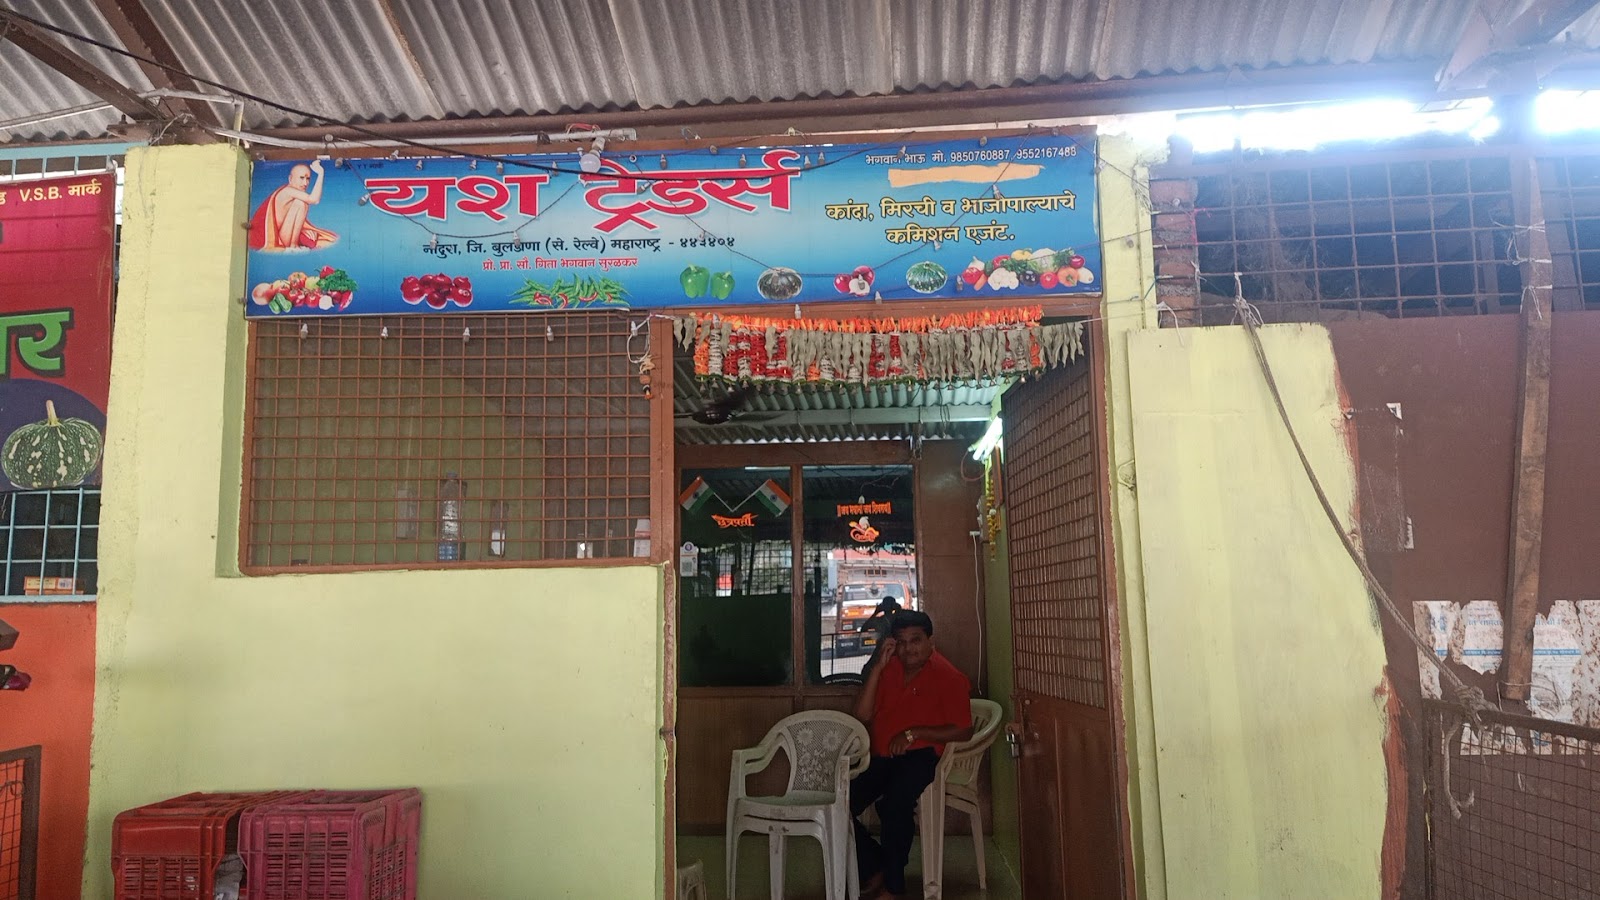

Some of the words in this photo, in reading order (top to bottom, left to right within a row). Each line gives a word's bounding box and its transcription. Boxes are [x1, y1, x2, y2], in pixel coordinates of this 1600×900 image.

[865, 154, 901, 165] भगवान
[904, 153, 926, 164] भाऊ
[932, 150, 947, 163] मो.
[1016, 146, 1077, 160] 9552167488
[67, 178, 102, 197] मार्क
[364, 174, 550, 222] यश
[579, 149, 801, 233] ट्रेडर्स
[824, 199, 875, 222] कांदा,
[880, 195, 936, 219] मिरची
[941, 199, 956, 217] व
[885, 222, 960, 245] कमिशन
[964, 220, 1016, 245] एजंट.
[466, 240, 487, 254] जि.
[491, 241, 541, 258] बुलडाणा
[573, 236, 606, 254] रेल्वे)
[610, 237, 662, 252] महाराष्ट्र
[535, 256, 558, 269] गिता
[560, 258, 596, 269] भगवान
[598, 257, 638, 272] सुरळकर
